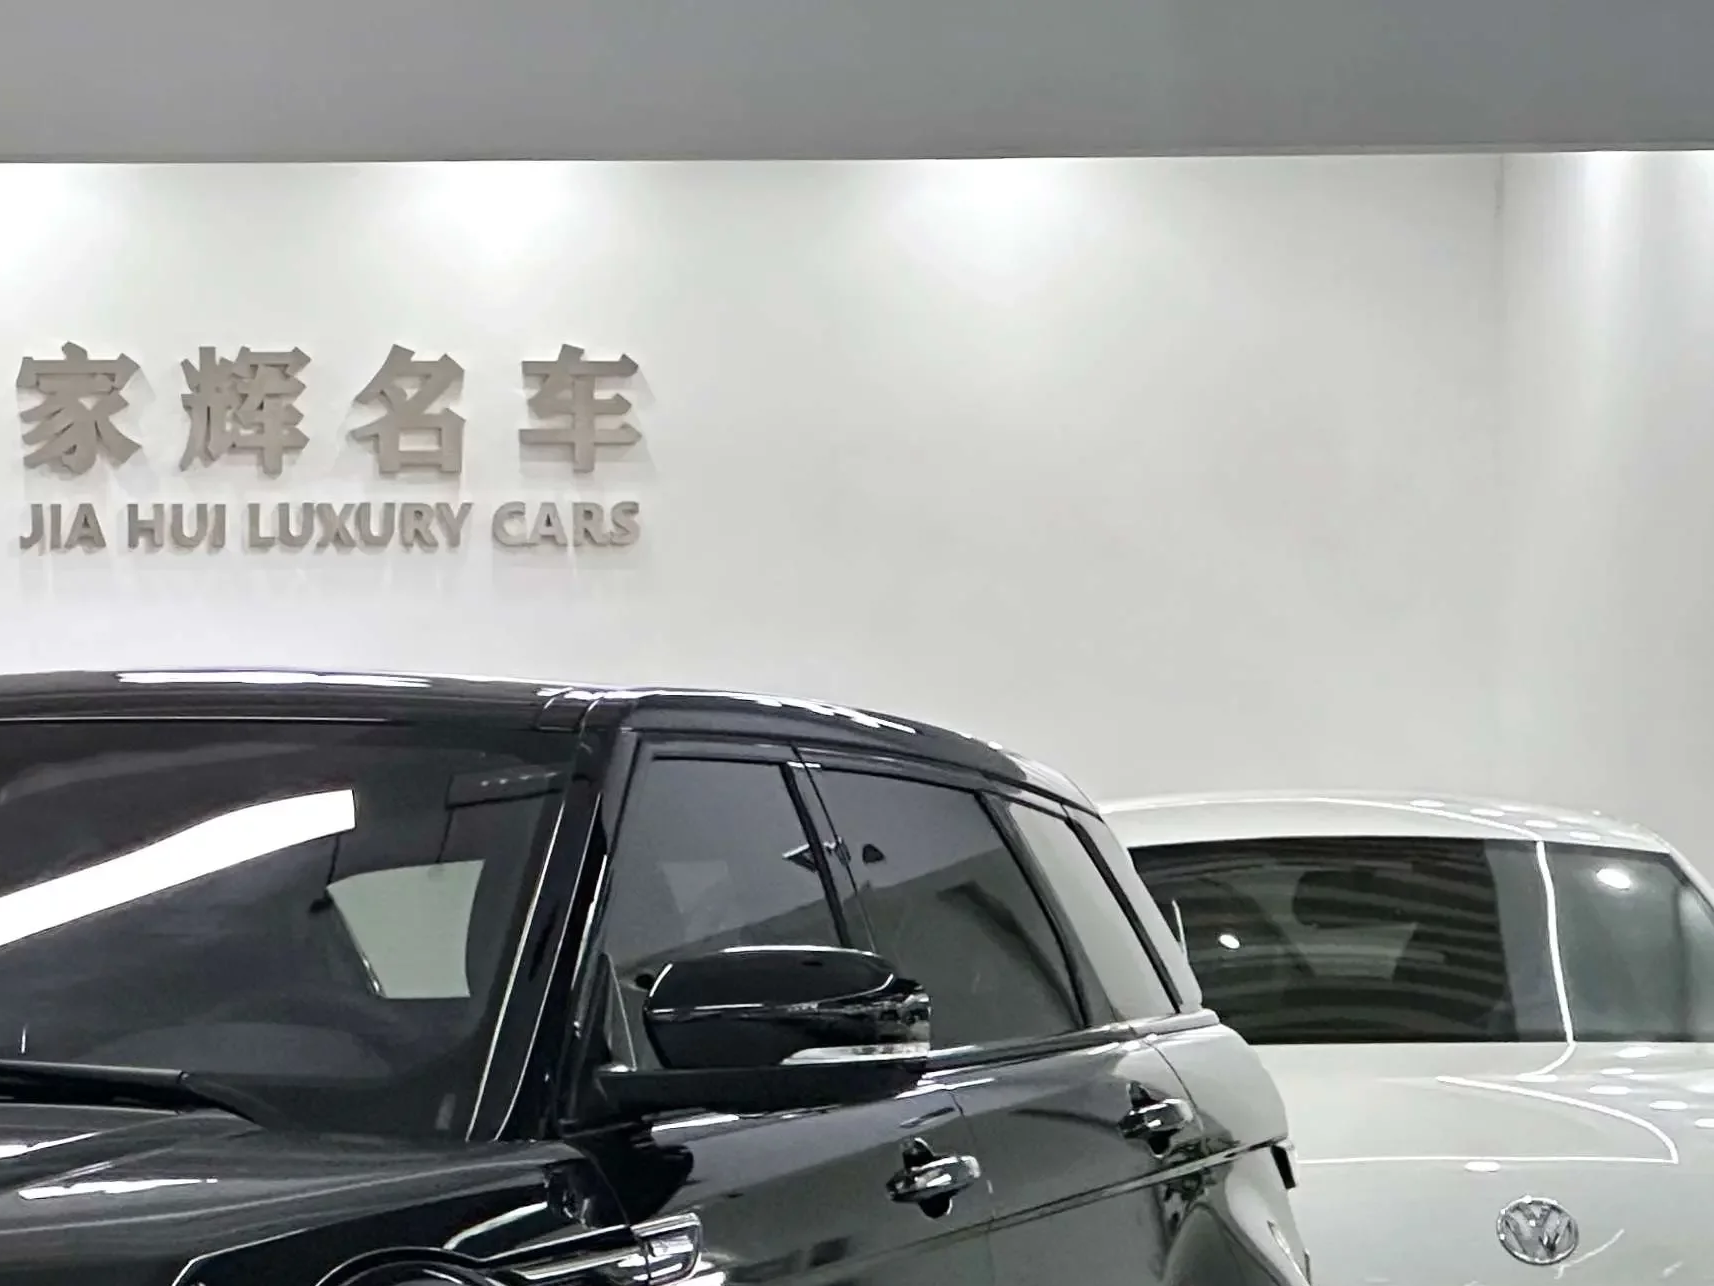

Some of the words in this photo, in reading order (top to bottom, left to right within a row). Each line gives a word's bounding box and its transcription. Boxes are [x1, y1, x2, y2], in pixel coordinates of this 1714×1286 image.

[17, 341, 642, 479] 家辉名车
[20, 503, 107, 550] JIA
[127, 503, 226, 550] HUI
[248, 502, 473, 550] LUXURY
[492, 501, 641, 550] CARS
